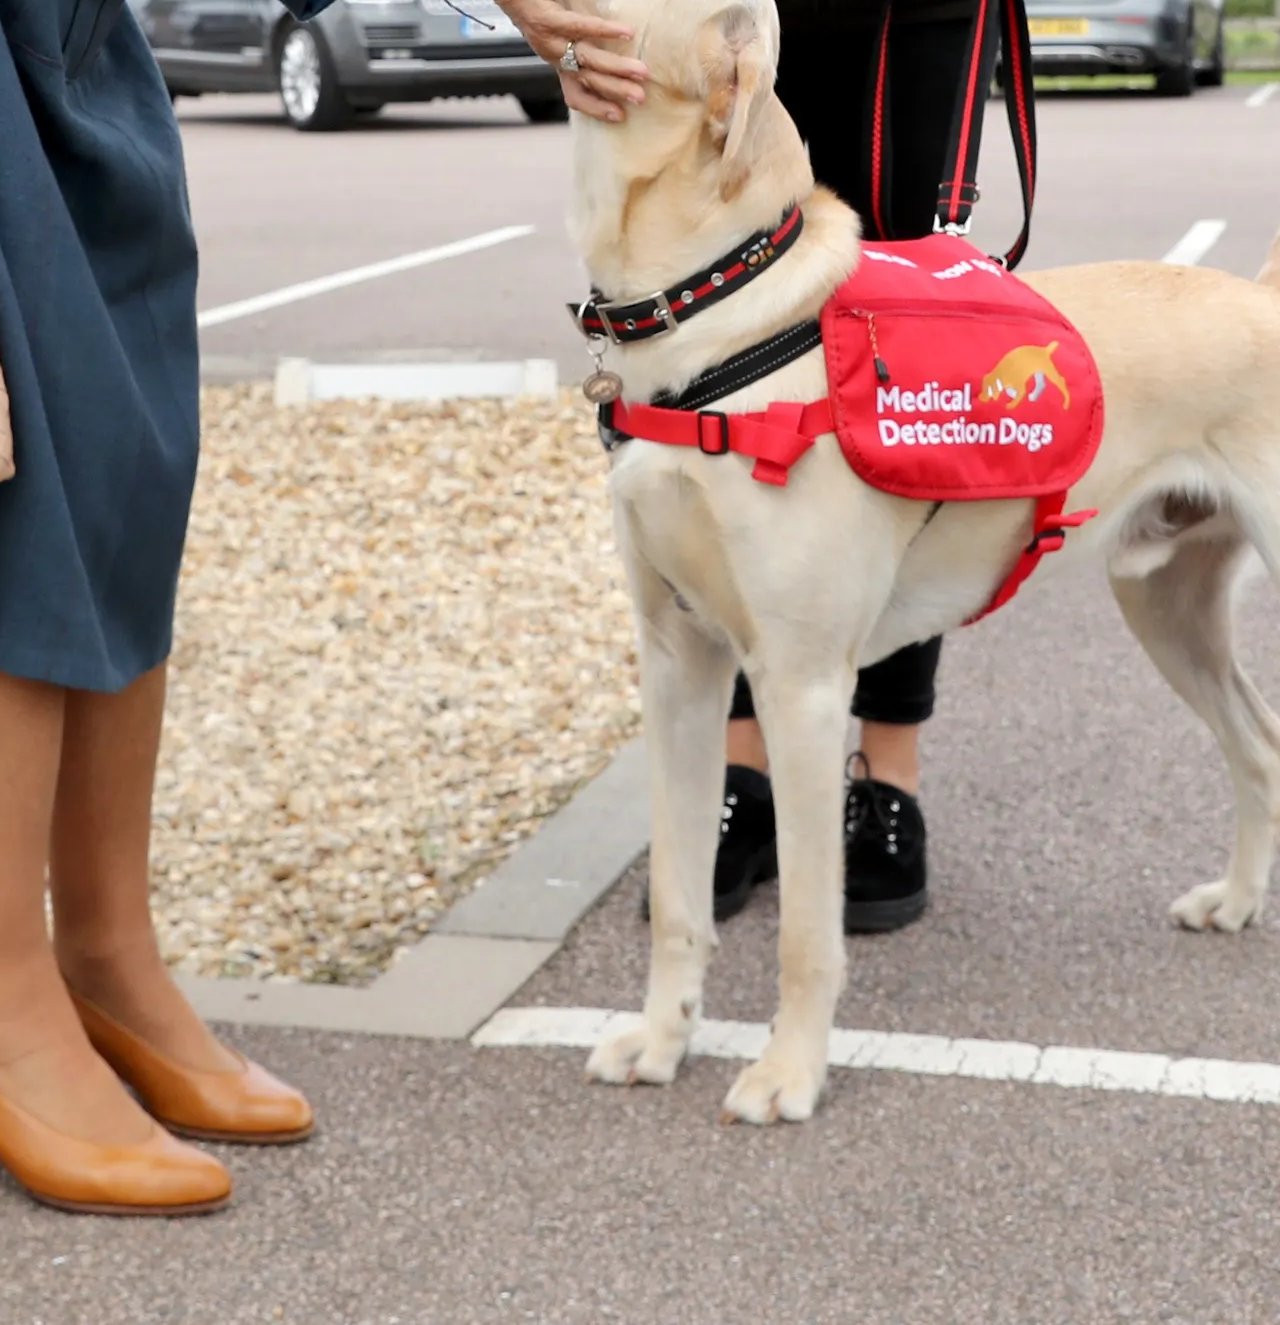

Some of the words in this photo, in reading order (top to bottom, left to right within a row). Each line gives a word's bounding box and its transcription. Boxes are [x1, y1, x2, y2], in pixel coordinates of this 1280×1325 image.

[876, 381, 973, 414] Medical
[877, 416, 997, 447] Detection
[998, 417, 1053, 452] Dogs
